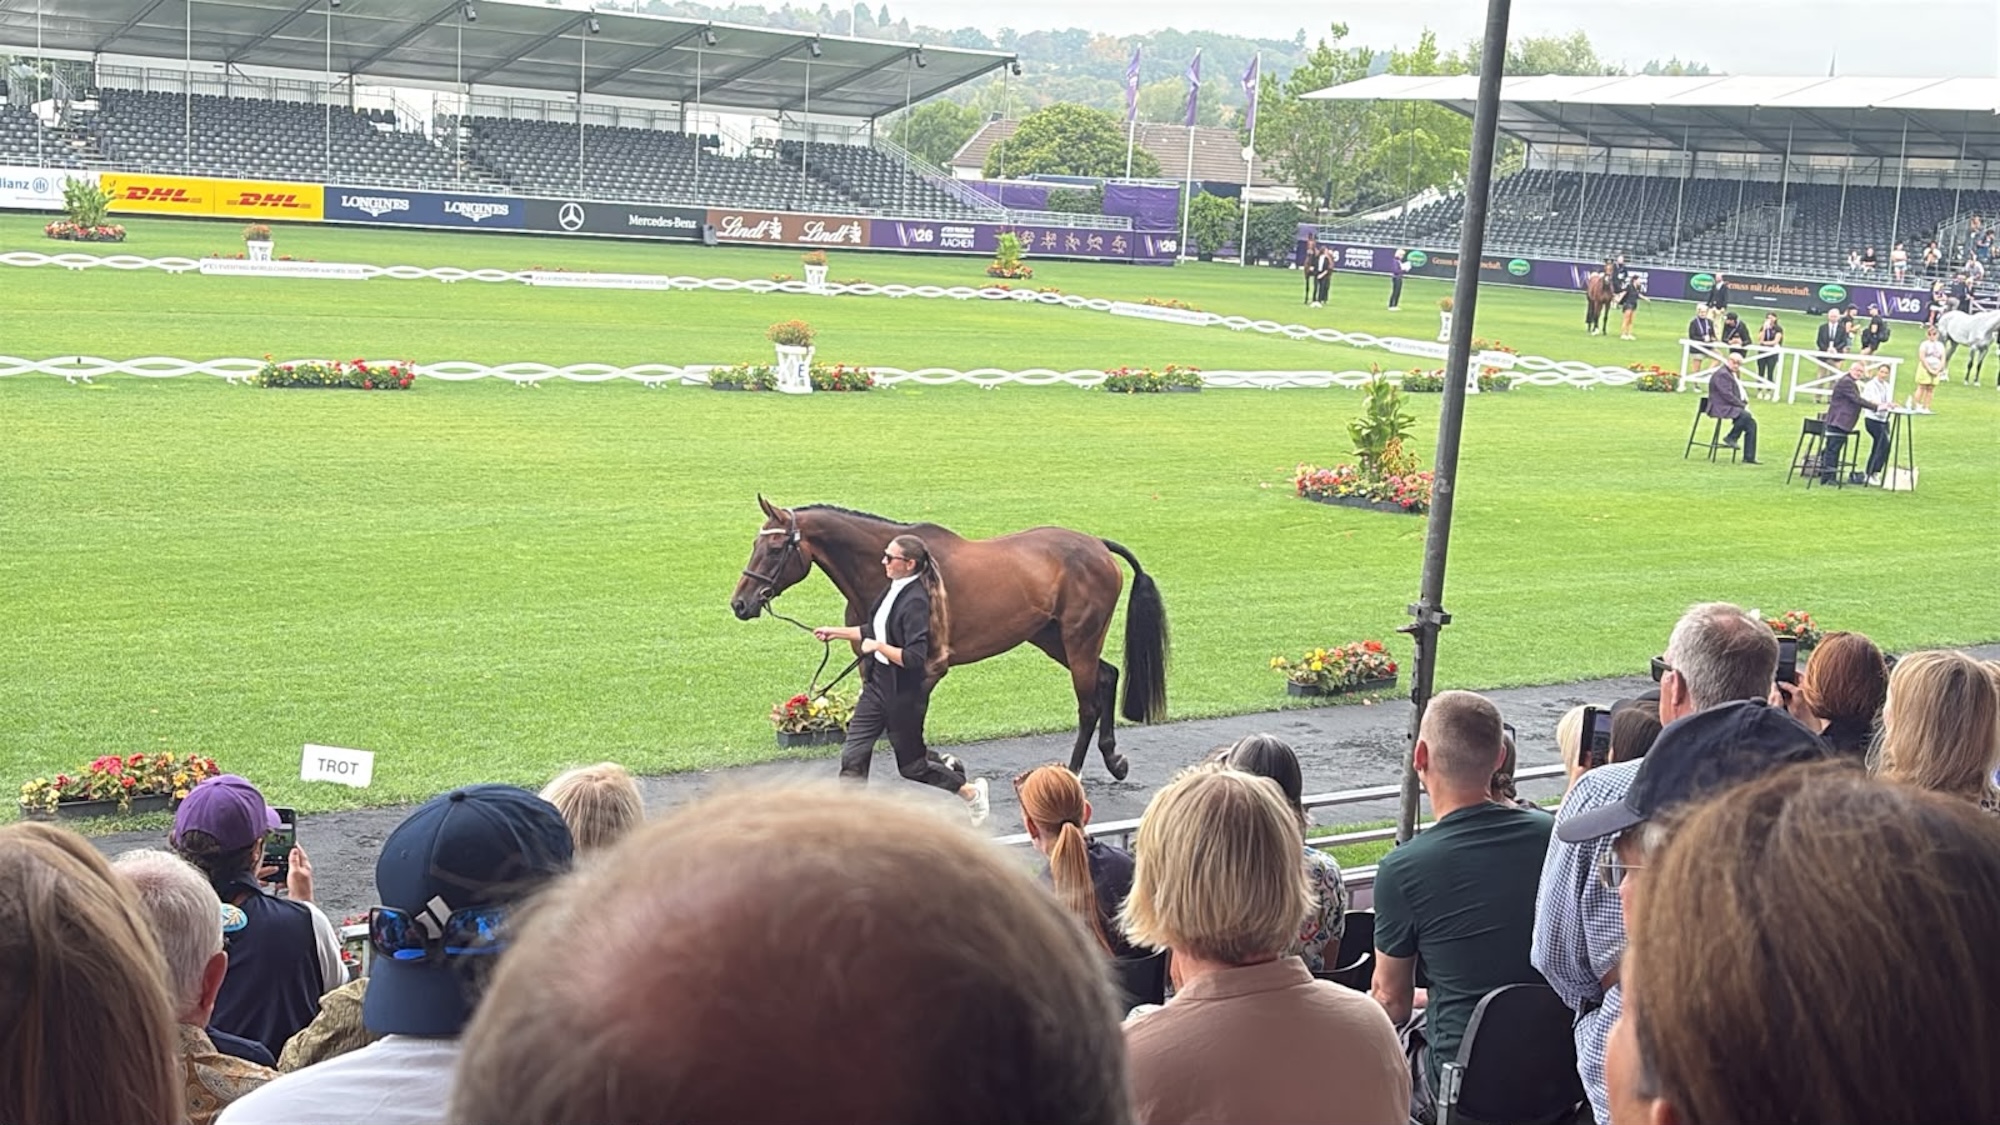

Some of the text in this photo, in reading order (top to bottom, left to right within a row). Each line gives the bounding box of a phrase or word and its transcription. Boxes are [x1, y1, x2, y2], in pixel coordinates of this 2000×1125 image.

[125, 186, 190, 203] DHL
[239, 192, 301, 208] DHL
[341, 195, 410, 211] LONGINES
[444, 201, 509, 216] LONGINES
[628, 214, 697, 229] Mercedes-Benz
[716, 216, 770, 239] Lindt
[798, 221, 850, 243] Lindt
[798, 363, 805, 378] E
[317, 757, 359, 775] TROT
